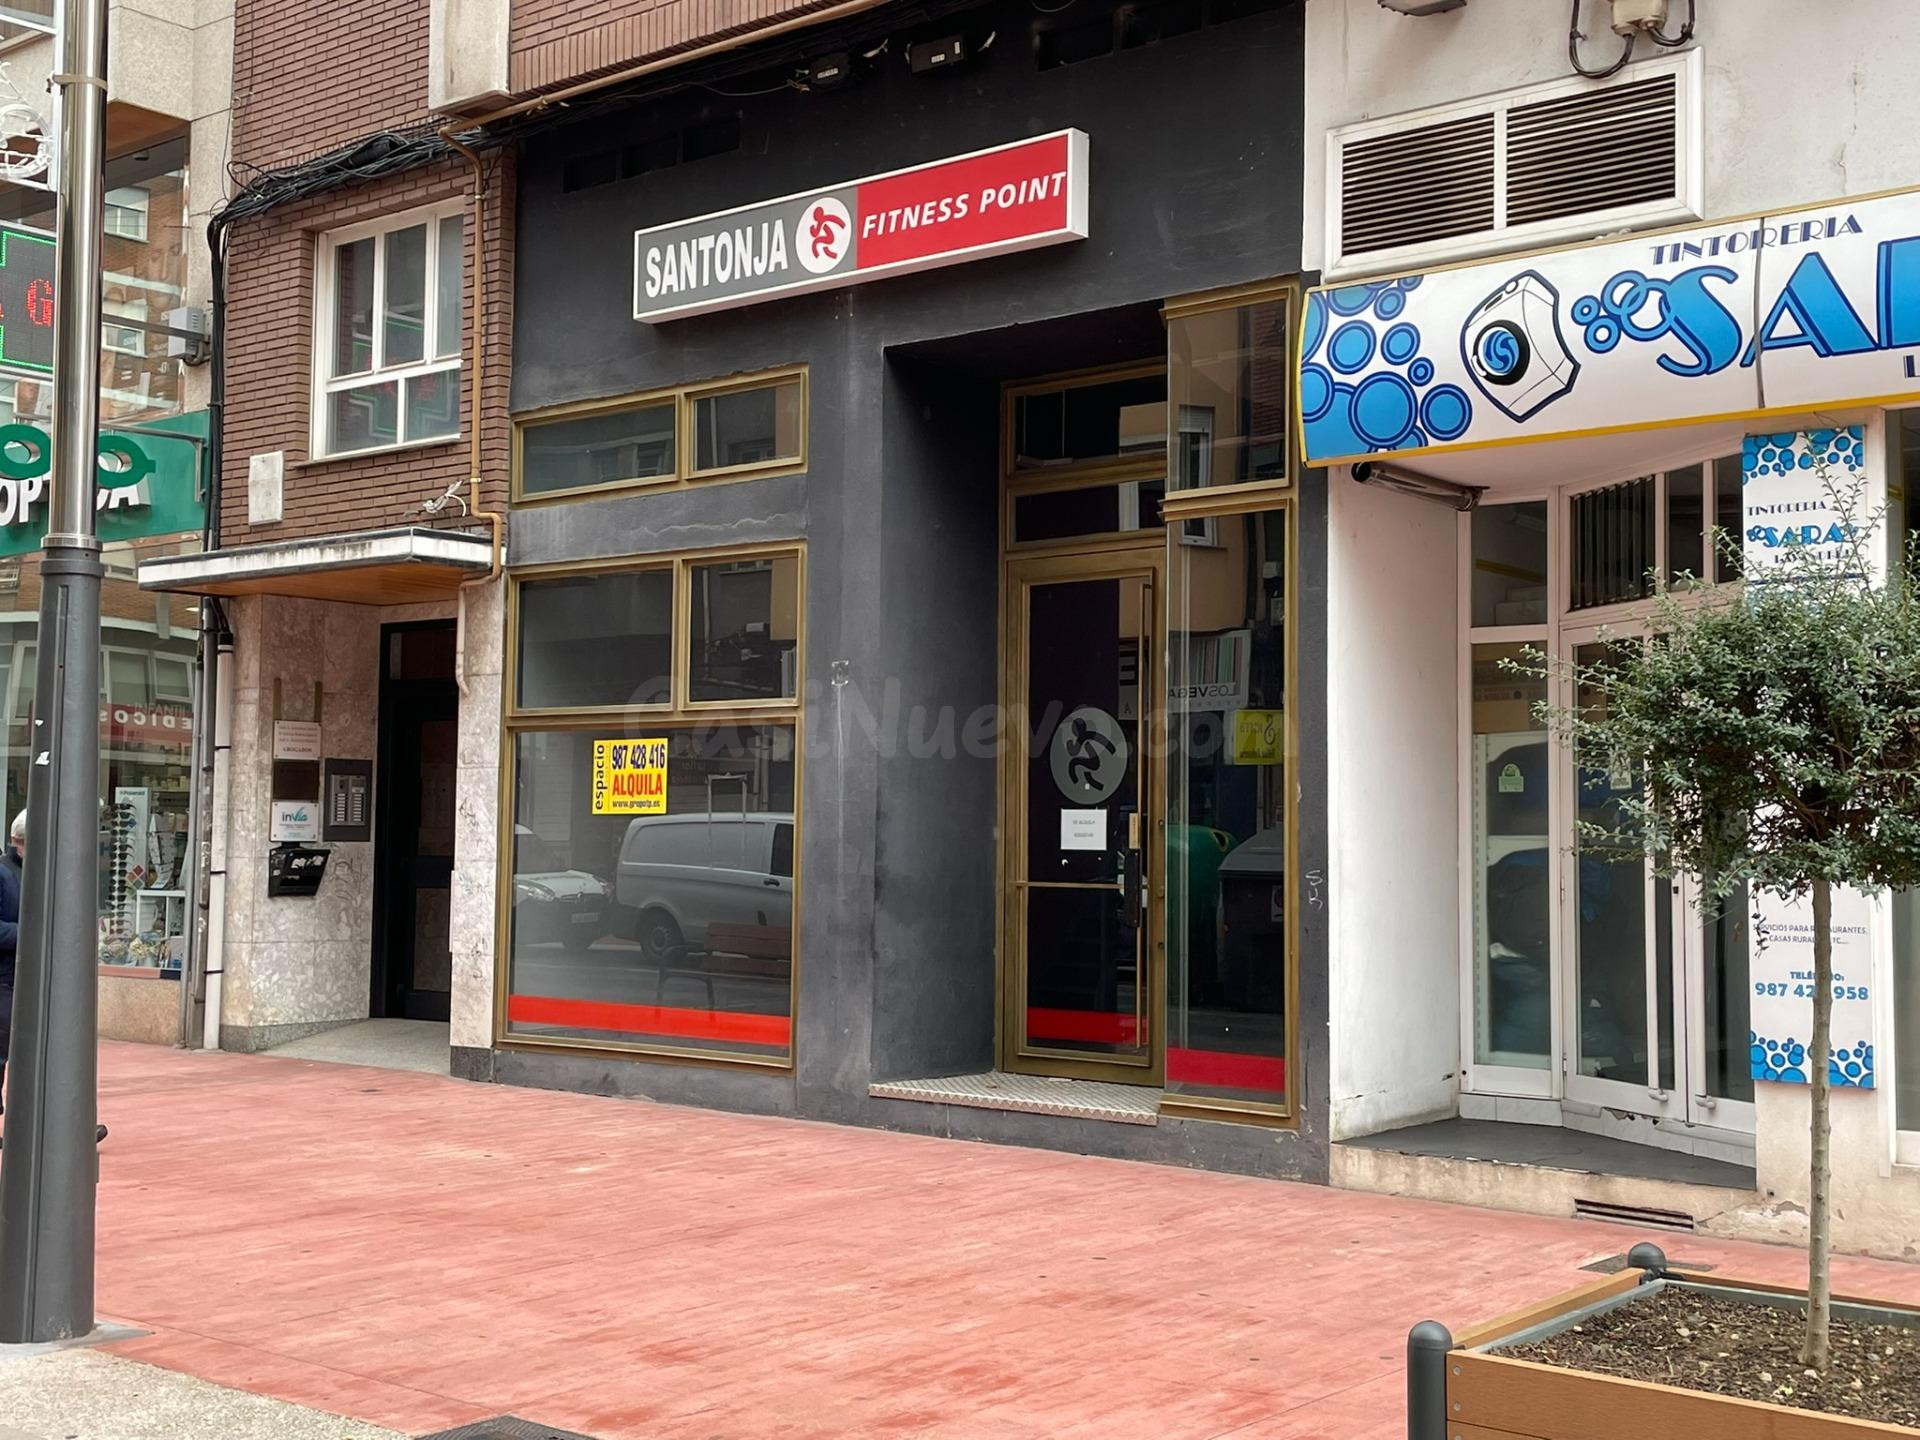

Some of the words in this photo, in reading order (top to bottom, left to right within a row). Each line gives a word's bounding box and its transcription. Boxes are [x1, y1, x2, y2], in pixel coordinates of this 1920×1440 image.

[862, 193, 970, 239] FITNESS
[979, 170, 1067, 214] POINT
[1650, 214, 1864, 266] TINTORERIA
[645, 218, 789, 298] SANTONJA
[1747, 500, 1827, 517] TINTORERIA
[1763, 521, 1846, 548] SARA
[612, 744, 629, 770] 987
[630, 743, 647, 769] 428
[648, 743, 666, 769] 416
[595, 744, 609, 810] espacio
[612, 773, 664, 797] ALQUILA
[1753, 923, 1788, 932] SRVICIOS
[1768, 935, 1791, 943] CASAS
[1755, 982, 1788, 997] 987
[1793, 984, 1817, 998] 42
[1834, 986, 1869, 1000] 958
